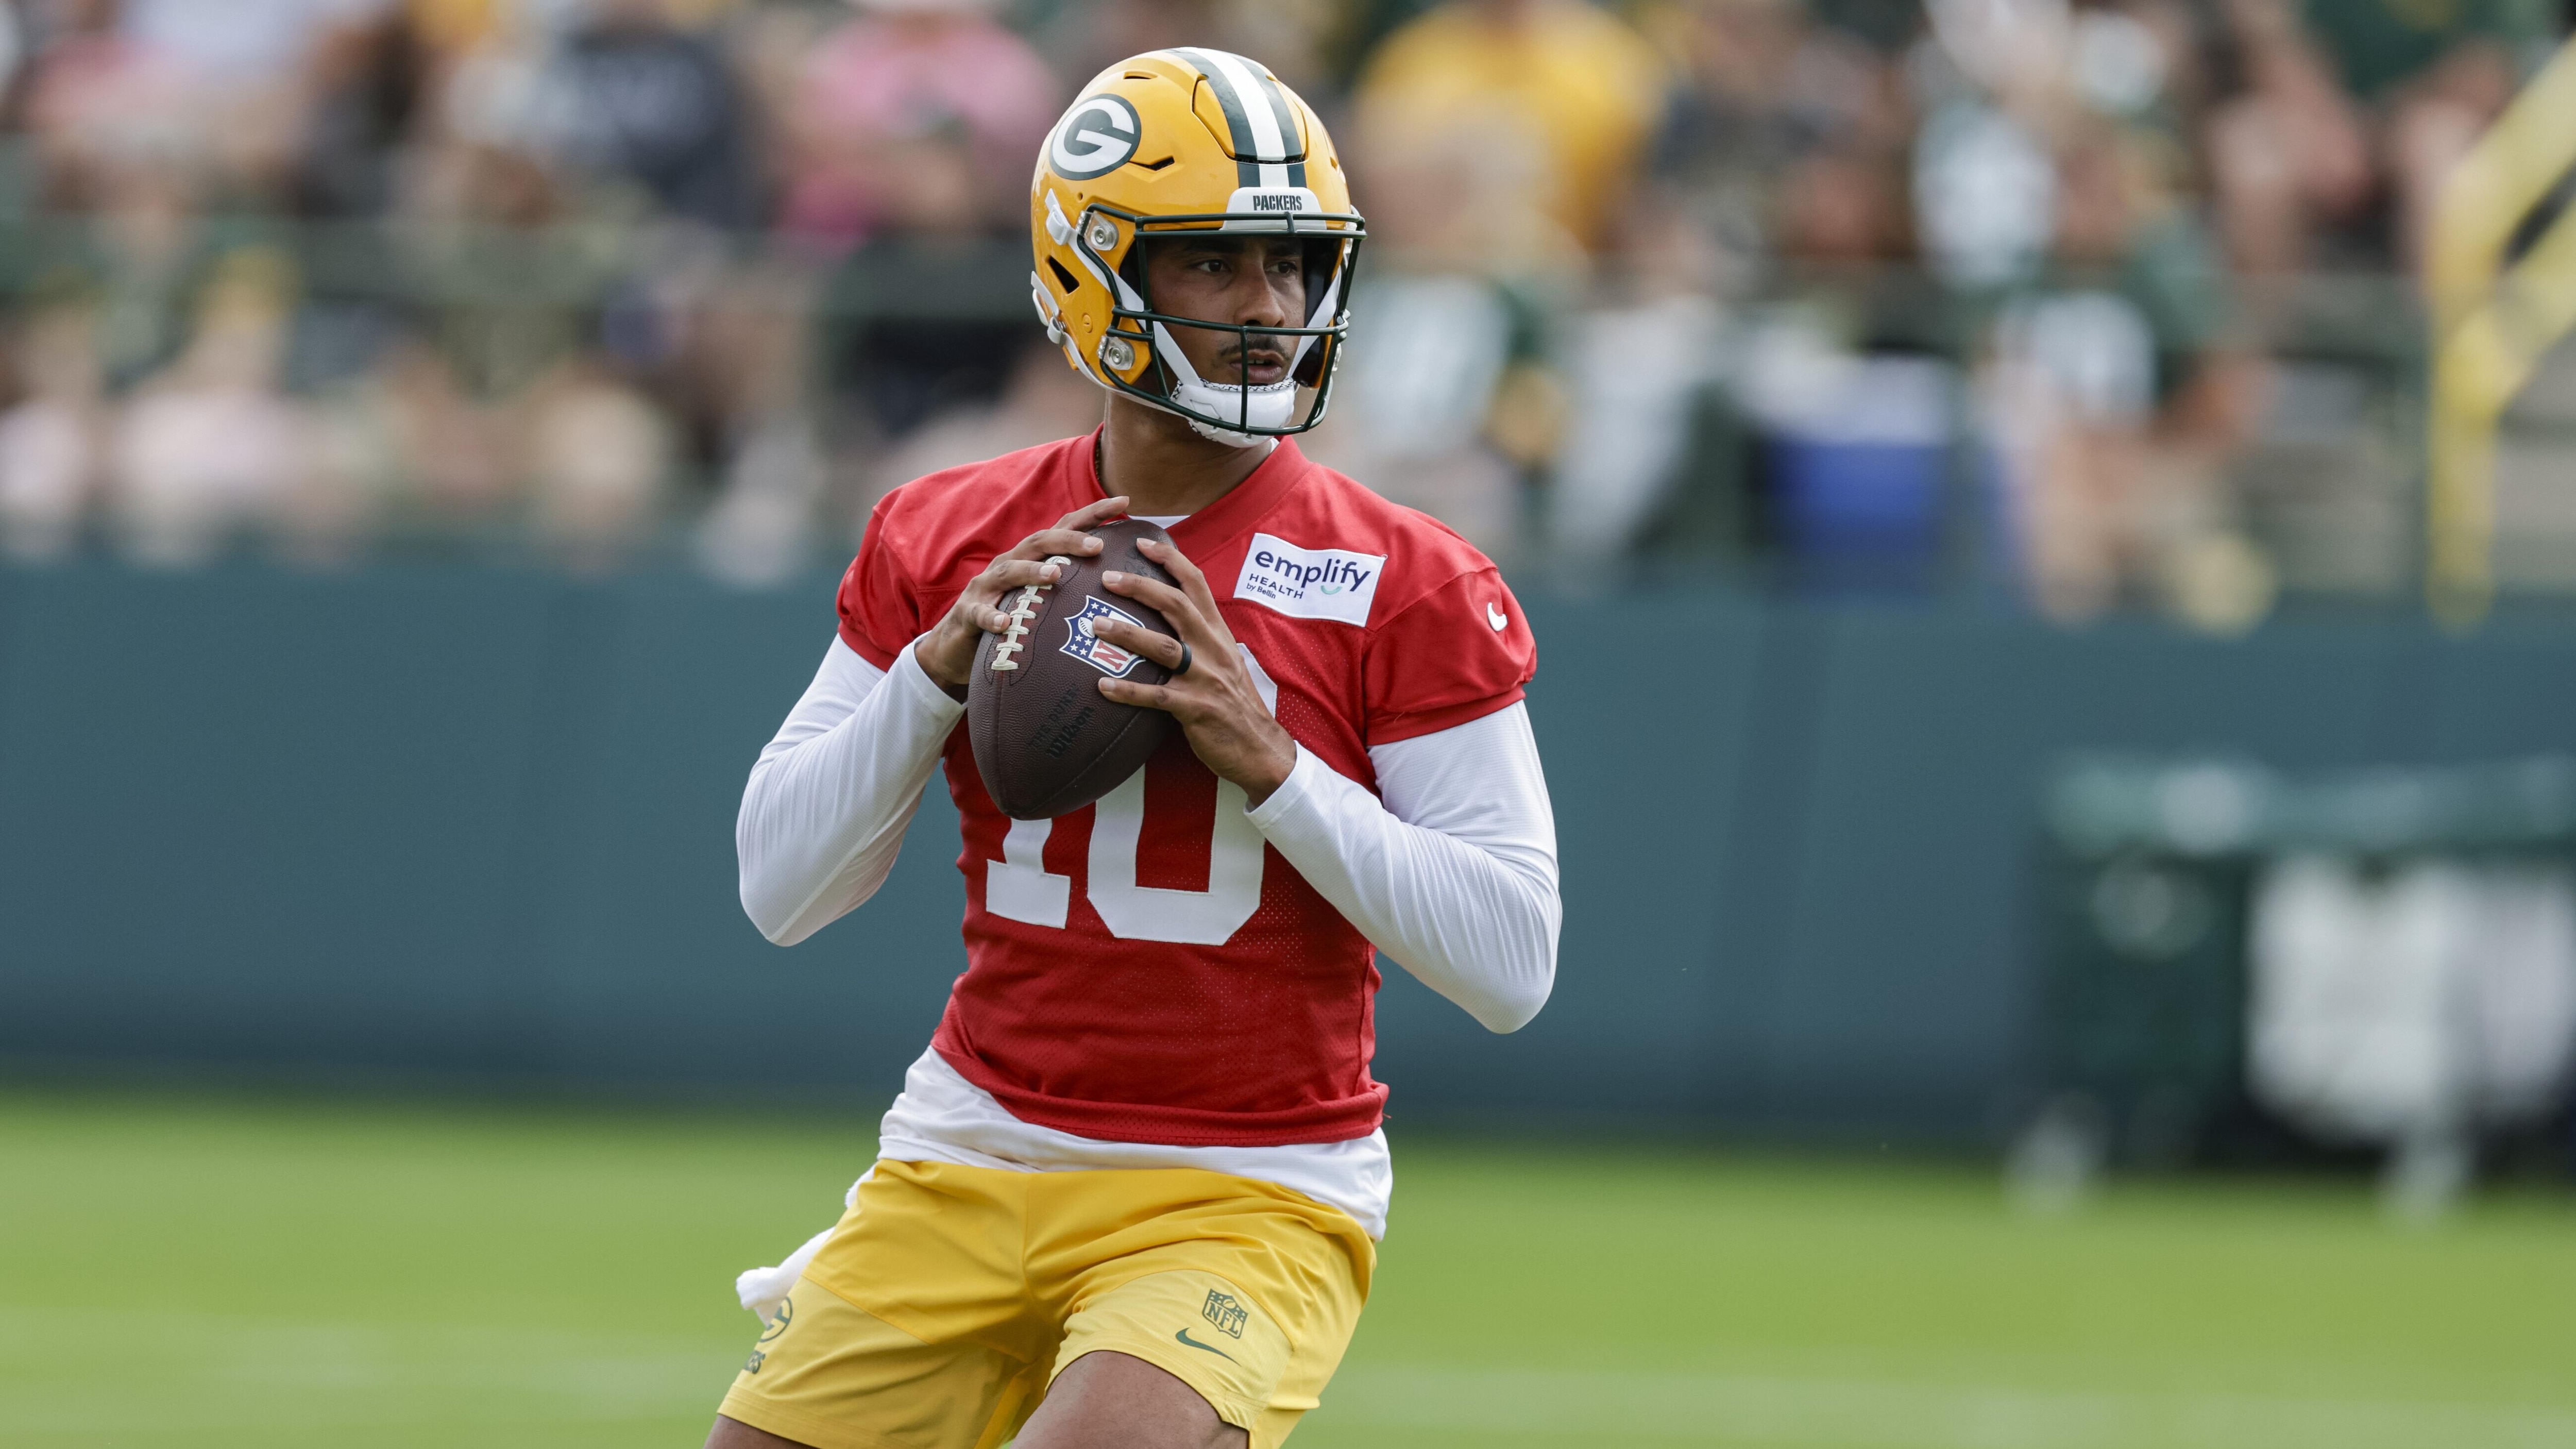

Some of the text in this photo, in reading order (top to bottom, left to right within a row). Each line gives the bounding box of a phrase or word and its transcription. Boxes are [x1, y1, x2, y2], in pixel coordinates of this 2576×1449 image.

[1052, 98, 1134, 173] G
[1252, 195, 1302, 211] PACKERS
[1249, 573, 1304, 599] HEALTH
[1255, 550, 1371, 592] emplify
[1246, 583, 1276, 599] by Bellin
[1045, 705, 1095, 760] Wilson
[1206, 1302, 1239, 1336] NFL
